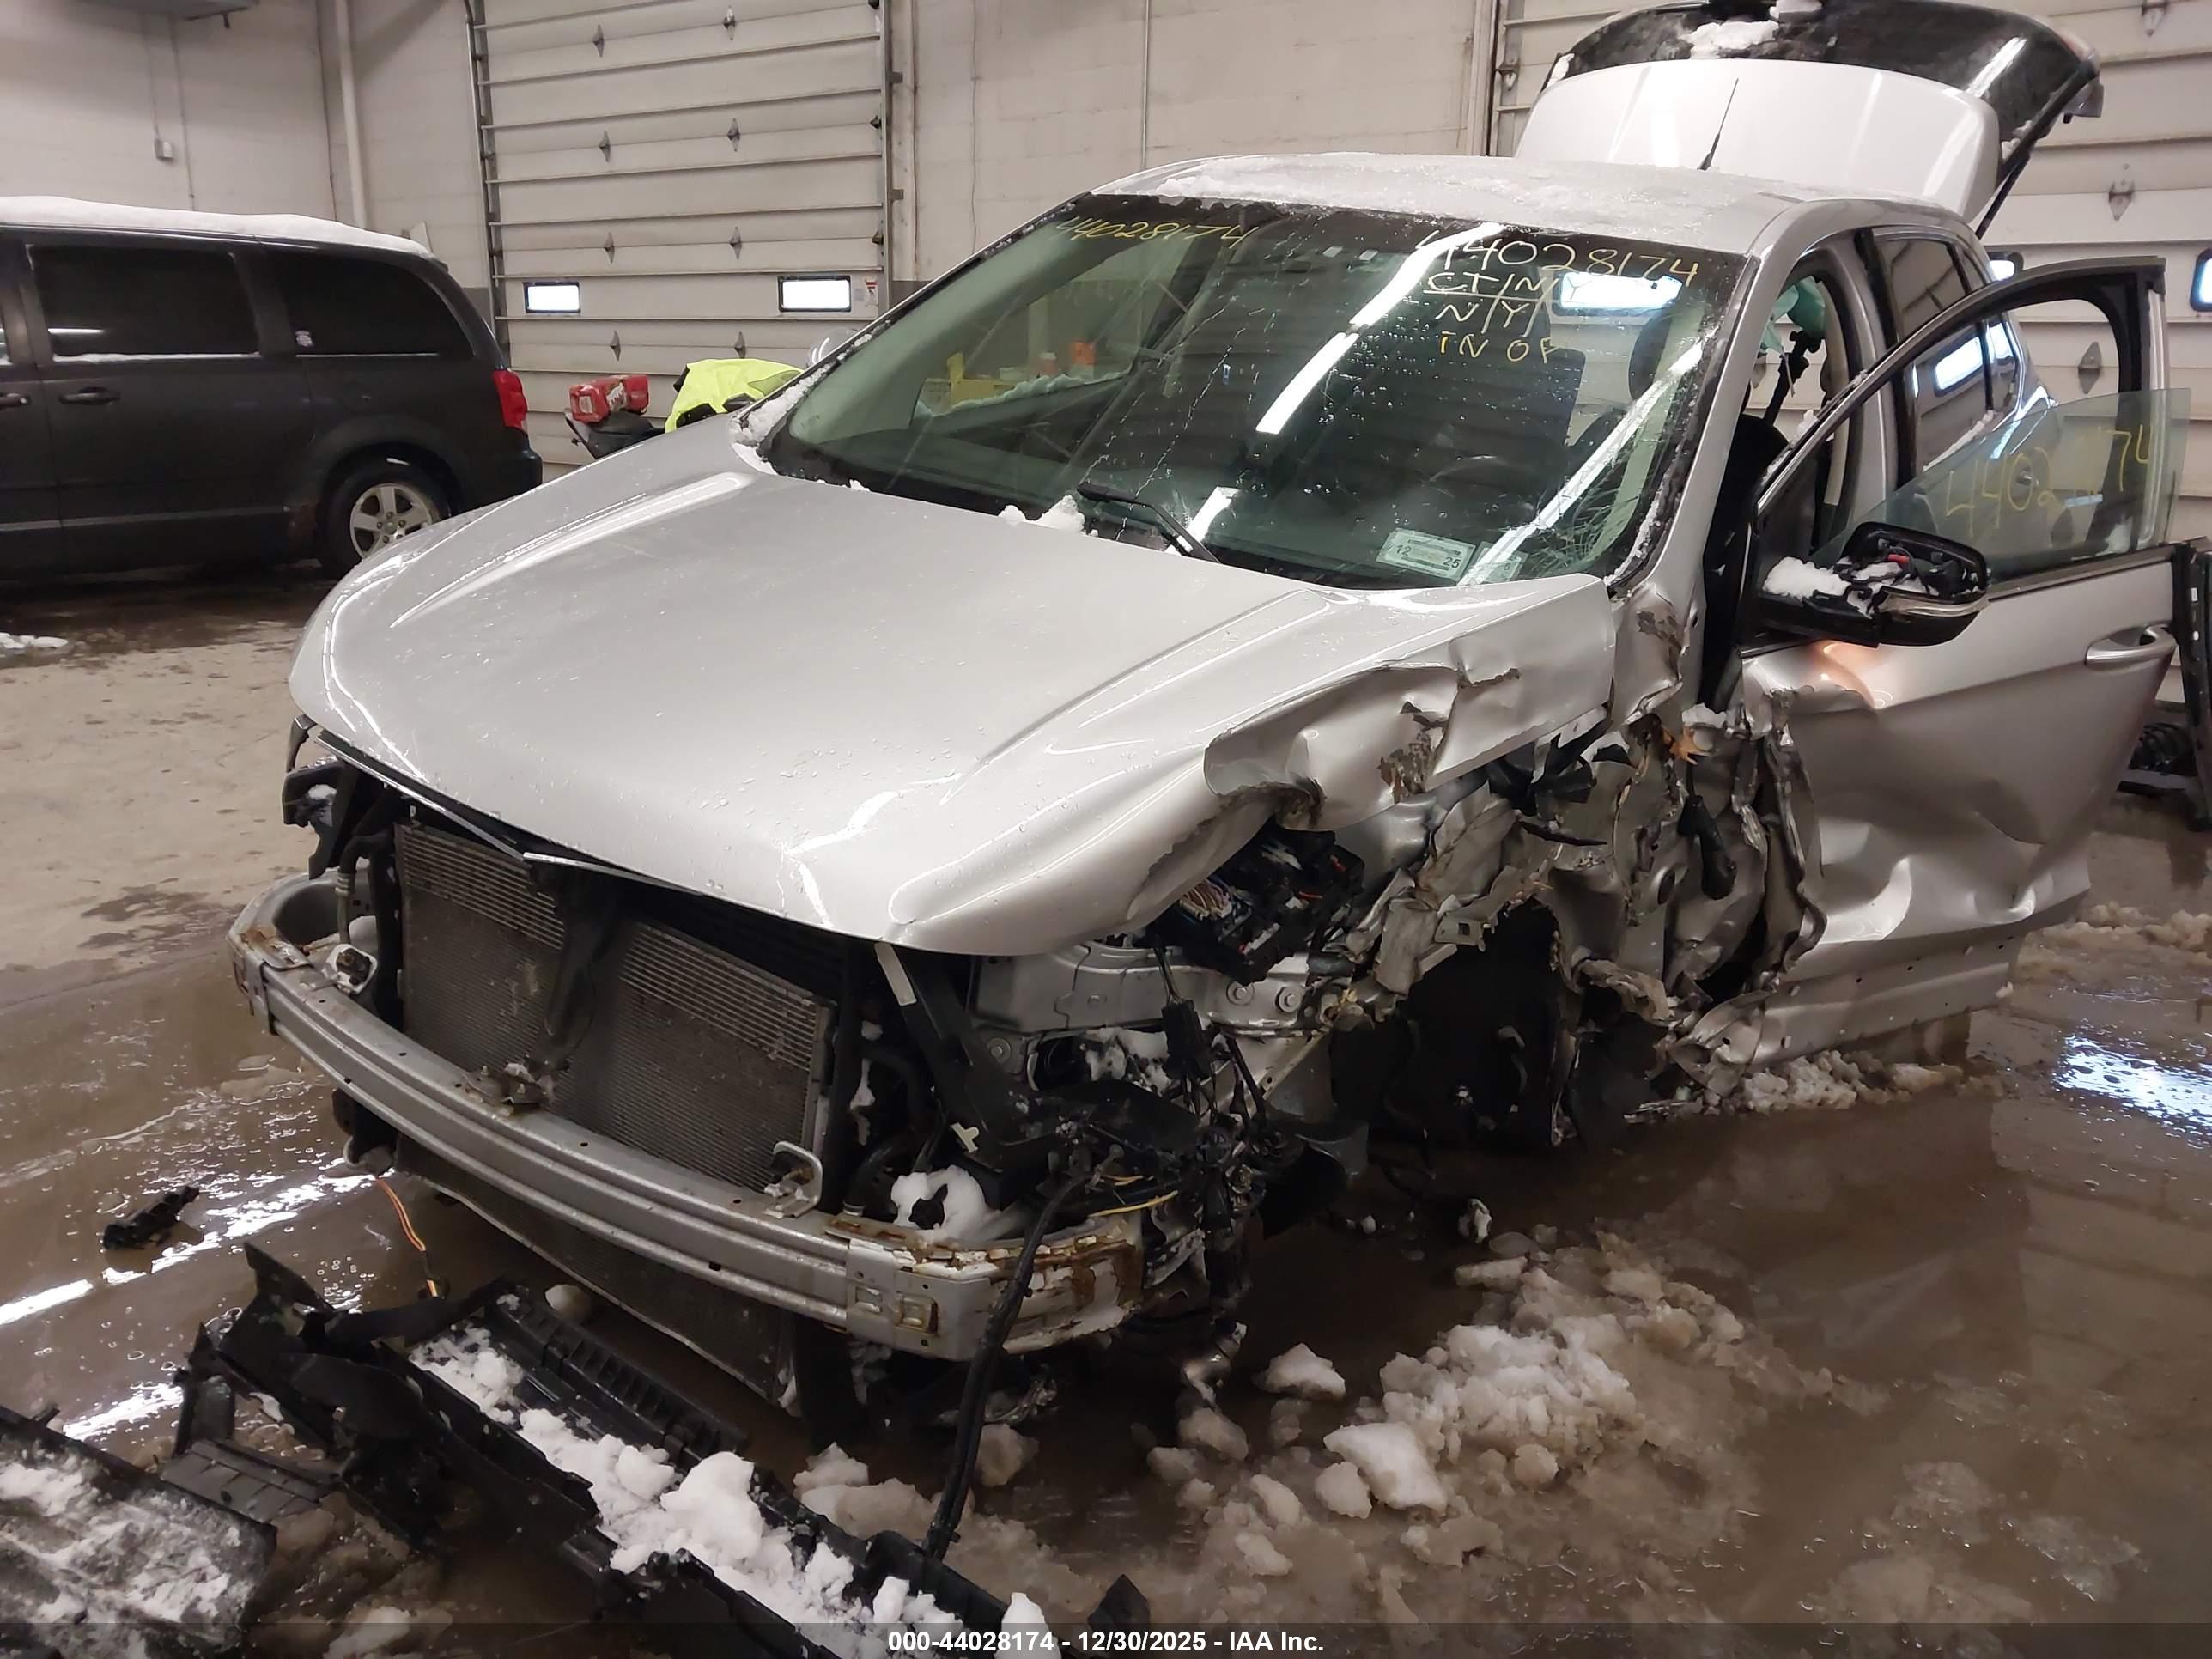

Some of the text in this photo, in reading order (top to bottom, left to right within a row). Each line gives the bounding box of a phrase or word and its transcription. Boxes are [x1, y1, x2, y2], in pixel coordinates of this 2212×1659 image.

[1056, 216, 1259, 249] 44028174
[1416, 230, 1698, 287] 44028174
[1946, 423, 2154, 539] 440274
[1396, 544, 1413, 556] 12
[1443, 557, 1462, 568] 25
